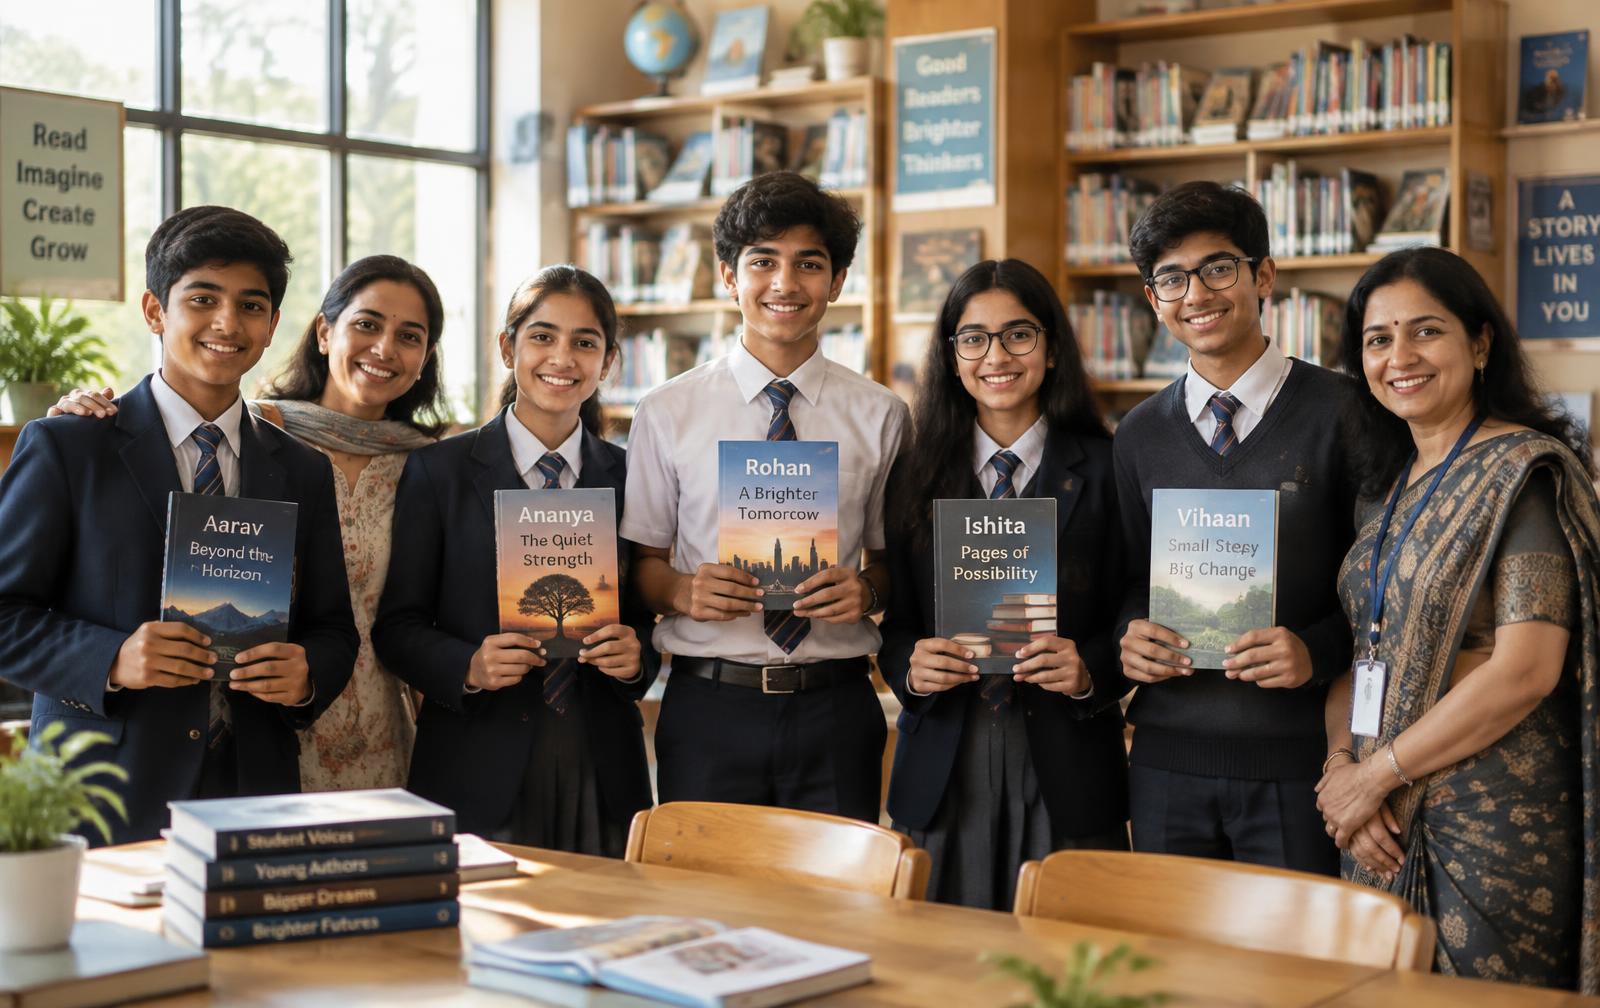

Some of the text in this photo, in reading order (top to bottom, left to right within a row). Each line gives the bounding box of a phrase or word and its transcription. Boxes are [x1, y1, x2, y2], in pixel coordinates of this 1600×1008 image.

[916, 52, 967, 76] Good
[33, 122, 87, 150] Read
[903, 118, 981, 145] Brighter
[902, 151, 984, 175] Thinkers
[16, 159, 104, 192] Imagine
[1558, 189, 1576, 210] A
[22, 198, 95, 226] Create
[1527, 214, 1600, 239] STORY
[30, 235, 88, 261] Grow
[1533, 243, 1595, 266] LIVES
[1553, 272, 1577, 293] IN
[1541, 301, 1589, 322] YOU
[746, 458, 811, 476] Rohan
[739, 486, 819, 504] A Brighter
[203, 515, 264, 536] Aarav
[518, 506, 594, 527] Ananya
[965, 516, 1026, 535] Ishita
[1177, 508, 1250, 528] Vihaan
[190, 541, 245, 560] Beyond
[520, 533, 593, 550] The Quiet
[1168, 538, 1209, 552] Small
[523, 552, 593, 569] Strength
[961, 545, 1030, 563] Pages of
[202, 563, 262, 582] Horizon
[954, 566, 1038, 584] Possibility
[1169, 562, 1256, 581] Big Change
[246, 831, 305, 850] Student
[307, 828, 355, 846] Voices
[255, 862, 308, 881] Young
[309, 858, 368, 876] Authors
[263, 887, 377, 912] Bigger Dreams
[252, 916, 379, 940] Brighter Futures
